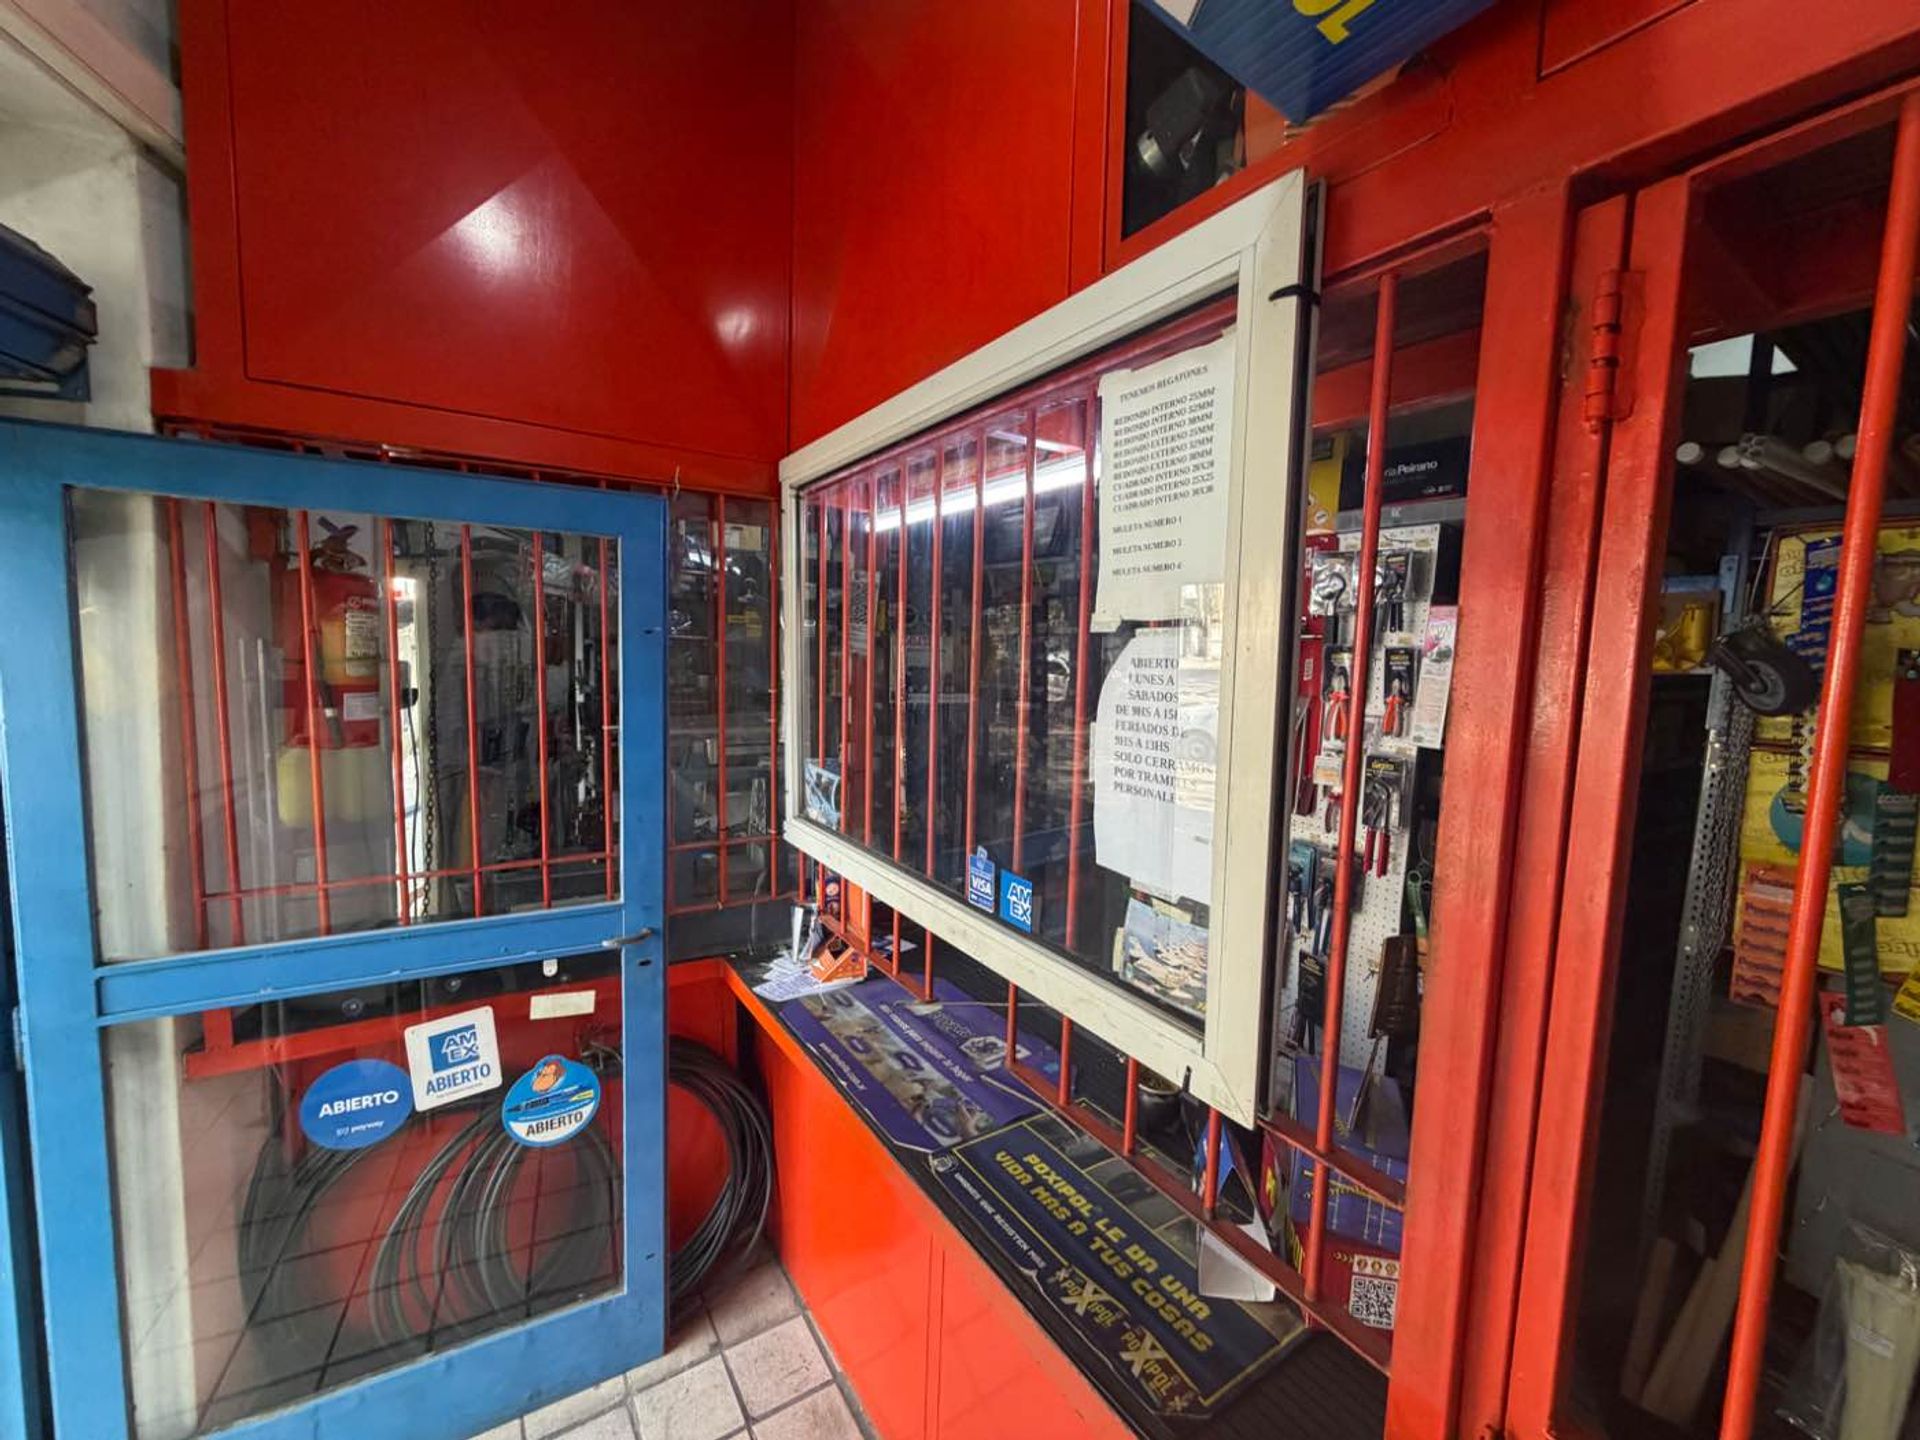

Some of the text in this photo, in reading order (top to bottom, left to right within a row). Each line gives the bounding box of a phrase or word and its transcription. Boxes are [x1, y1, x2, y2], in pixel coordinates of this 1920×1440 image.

[1114, 407, 1150, 425] REDONDO
[1152, 395, 1187, 414] INTERNO
[1114, 419, 1150, 437] REDONDO
[1152, 407, 1187, 426] INTERNO
[1113, 443, 1150, 459] REDONDO
[1151, 431, 1188, 449] EXTERNO
[1114, 431, 1150, 449] REDONDO
[1151, 420, 1186, 437] INTERNO
[1113, 454, 1150, 470] REDONDO
[1151, 443, 1188, 460] EXTERNO
[1113, 465, 1150, 481] REDONDO
[1150, 455, 1188, 471] EXTERNO
[1112, 475, 1155, 492] CUADRADO
[1156, 466, 1190, 482] INTERNO
[1112, 487, 1155, 503] CUADRADO
[1156, 478, 1190, 494] INTERNO
[1112, 498, 1155, 514] CUADRADO
[1155, 489, 1190, 506] INTERNO
[1131, 657, 1179, 670] ABIERTO
[1166, 674, 1175, 687] A
[1128, 689, 1179, 704] SABADOS
[1115, 704, 1129, 716] DE
[1153, 707, 1161, 720] A
[1115, 719, 1169, 737] FERIADOS
[1114, 750, 1143, 765] SOLO
[1135, 738, 1143, 749] A
[1145, 740, 1170, 753] 13HS
[1114, 766, 1135, 781] POR
[1114, 781, 1176, 804] PERSONALE
[971, 874, 992, 895] VISA
[442, 1030, 479, 1053] AM
[448, 1044, 479, 1062] EX
[426, 1063, 491, 1096] ABIERTO
[318, 1090, 399, 1118] ABIERTO
[526, 1111, 583, 1137] ABIERTO
[1022, 1153, 1211, 1320] POXIPOL LE DA UNA
[995, 1150, 1033, 1186] VIDA
[1067, 1220, 1088, 1236] A
[1089, 1236, 1134, 1278] TUS
[1131, 1278, 1214, 1352] COSAS
[1060, 1279, 1118, 1328] POXIPOL
[1119, 1331, 1174, 1397] POXIPOL
